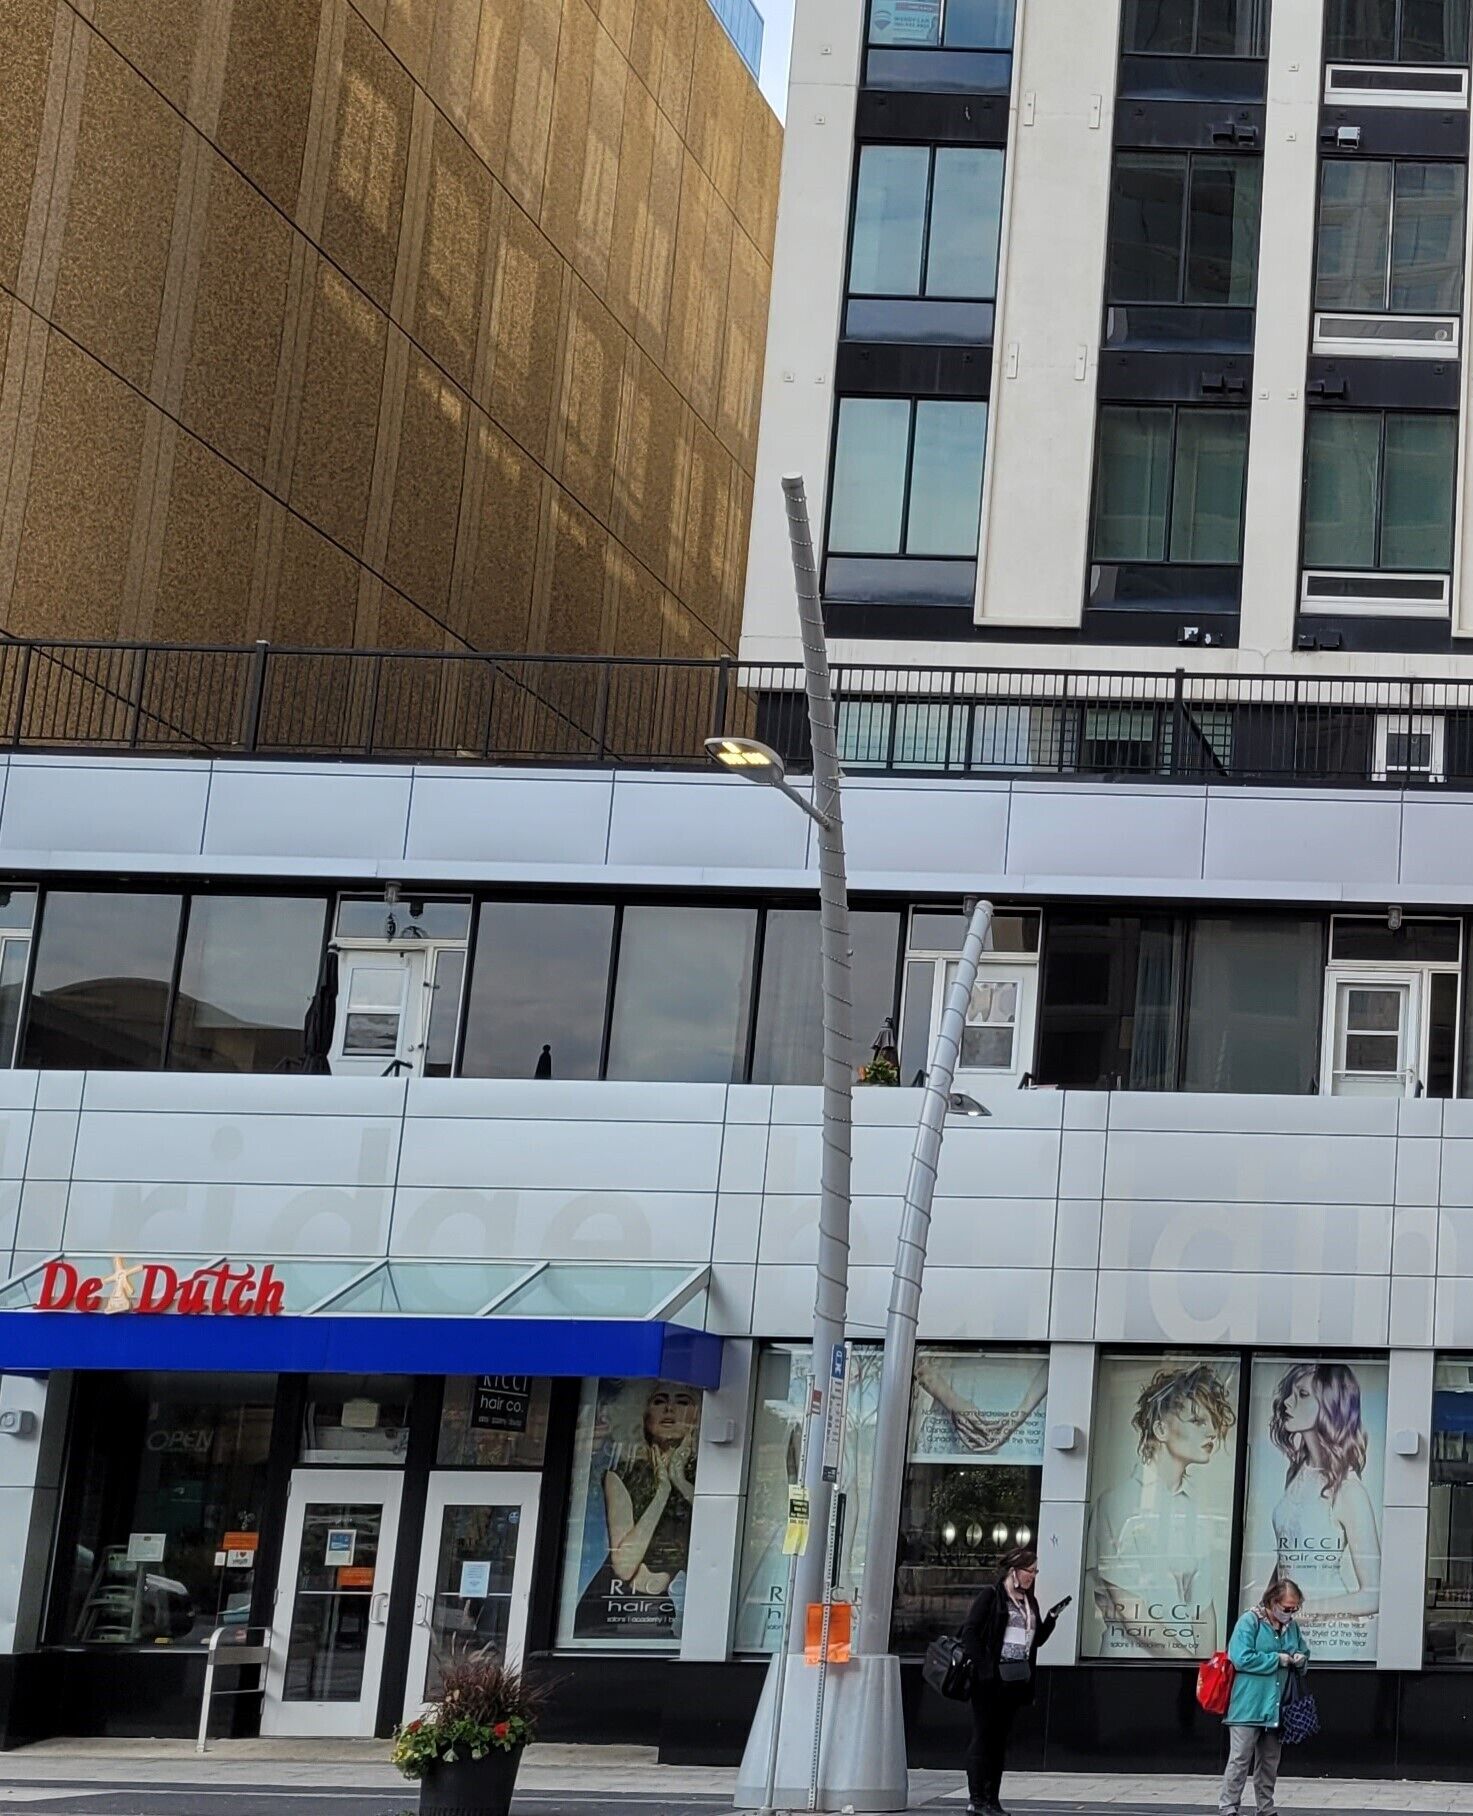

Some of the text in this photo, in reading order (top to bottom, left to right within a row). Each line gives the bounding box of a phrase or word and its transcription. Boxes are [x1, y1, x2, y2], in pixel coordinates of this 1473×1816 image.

[33, 1262, 285, 1316] De Dutch
[480, 1394, 525, 1413] hair co.
[1279, 1537, 1341, 1549] RICCI
[609, 1578, 685, 1595] RICC
[769, 1586, 859, 1603] RCI
[607, 1600, 653, 1613] hair
[1114, 1603, 1201, 1620] RICCI
[1111, 1625, 1201, 1639] hair co.
